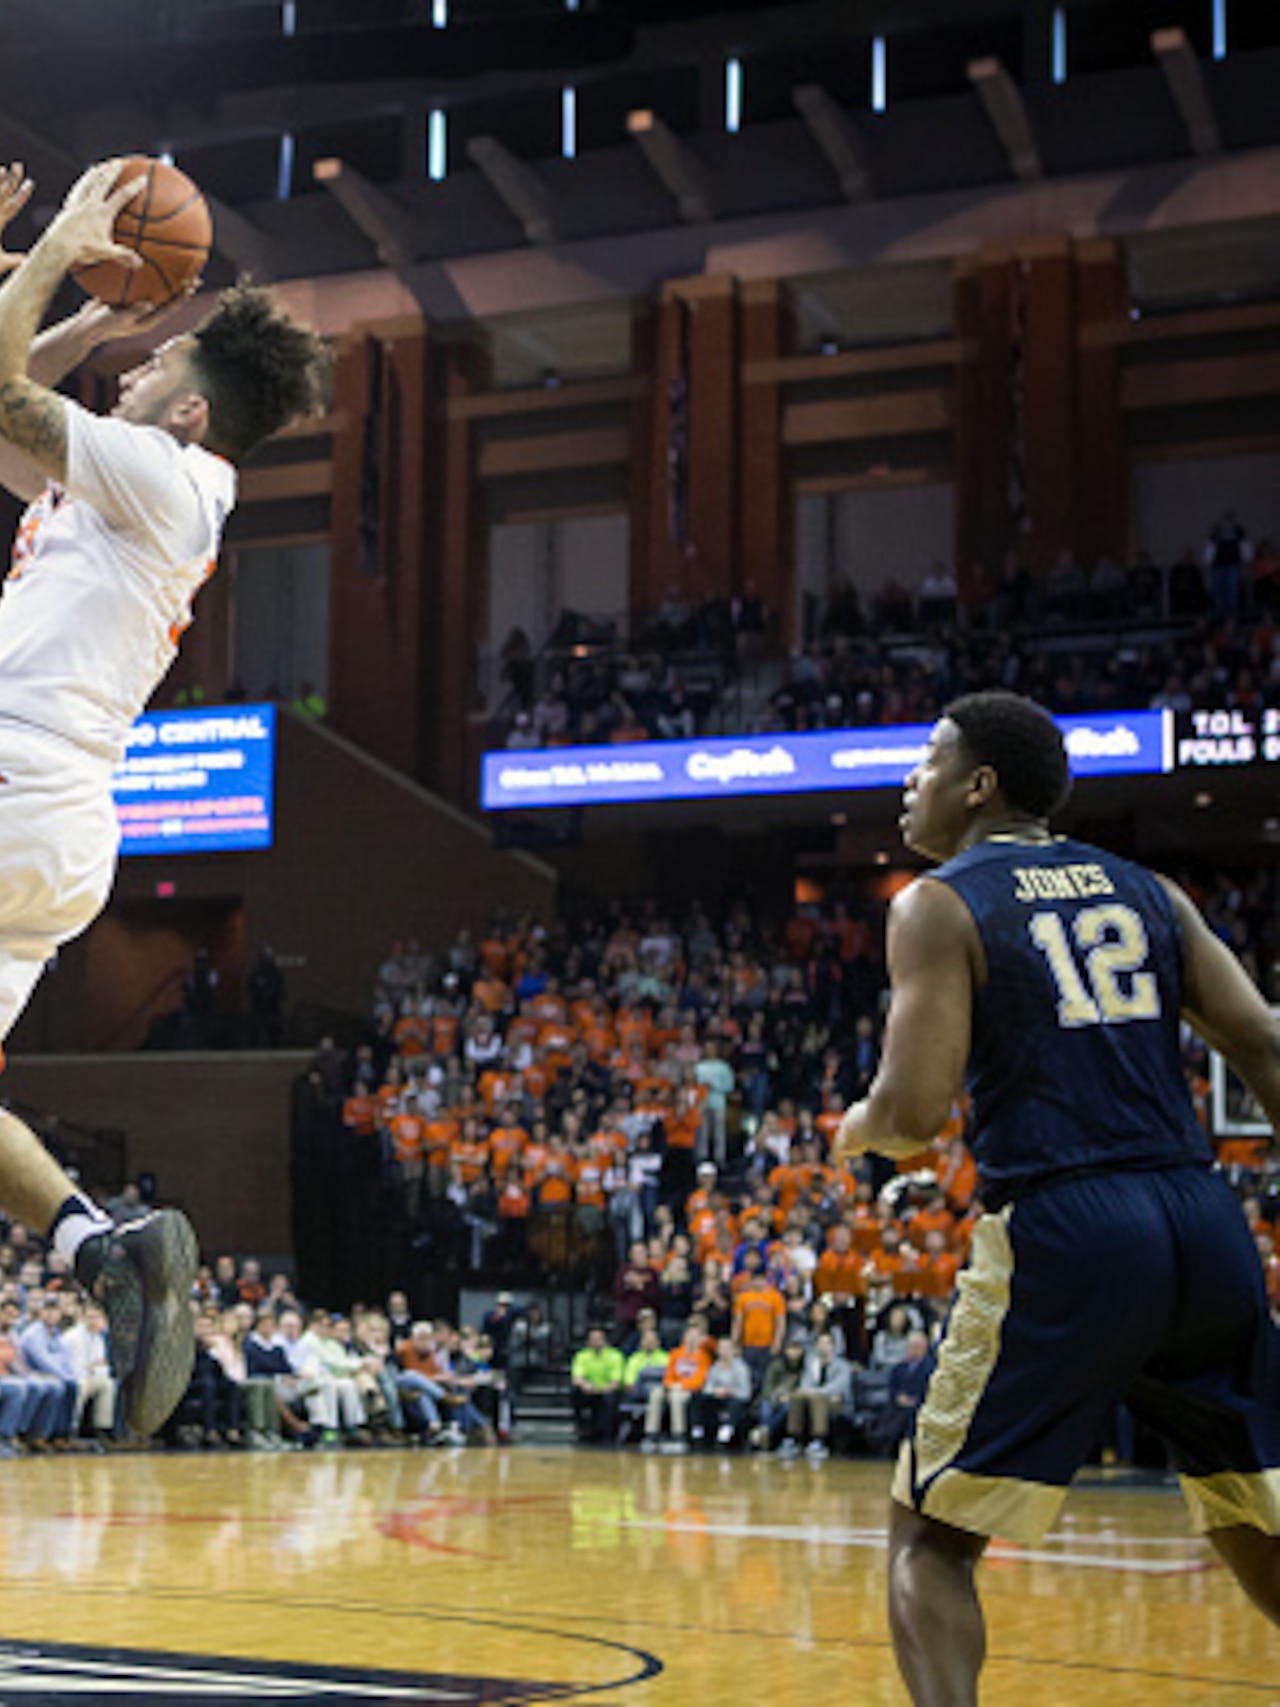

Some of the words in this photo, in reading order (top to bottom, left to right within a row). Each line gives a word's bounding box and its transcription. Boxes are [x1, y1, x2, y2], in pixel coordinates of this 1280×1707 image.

[688, 746, 795, 783] CapTech
[1179, 736, 1255, 764] FOULS
[1012, 863, 1115, 903] JONES
[1028, 902, 1162, 1029] 12
